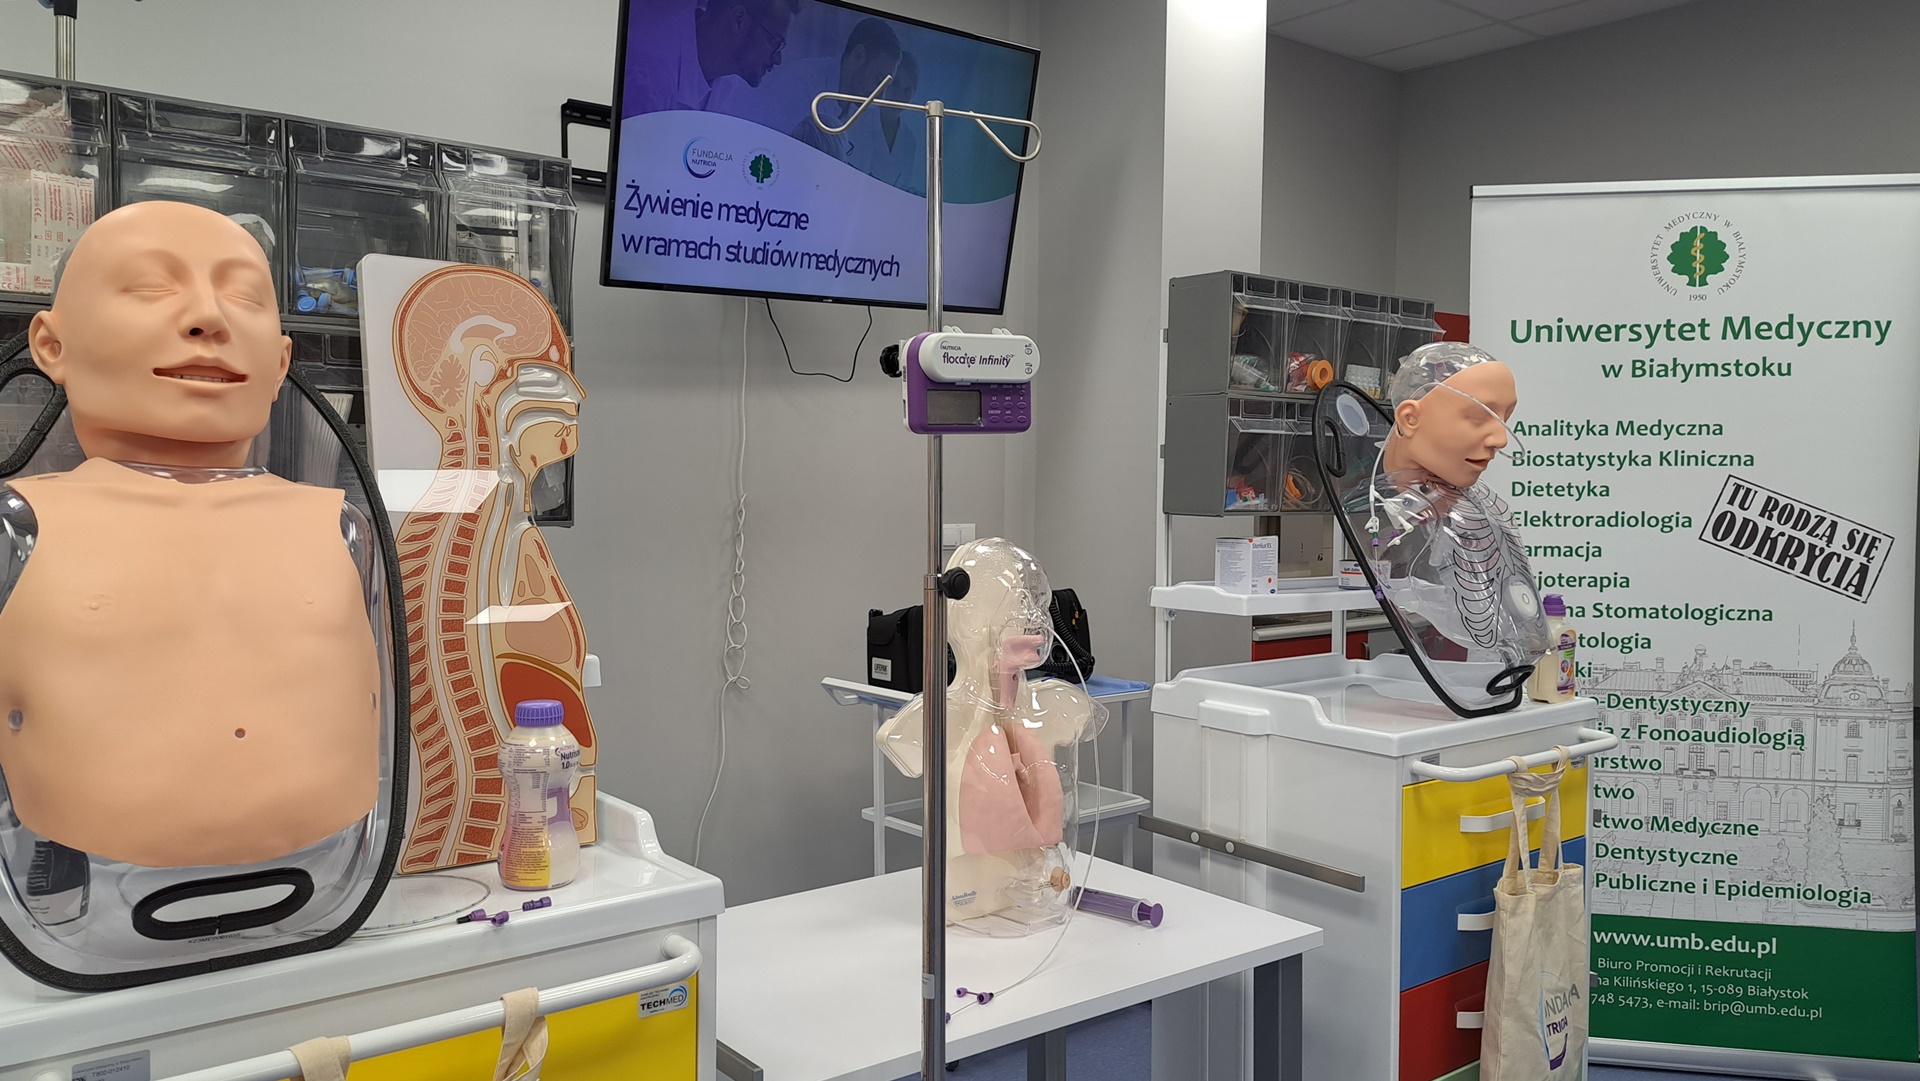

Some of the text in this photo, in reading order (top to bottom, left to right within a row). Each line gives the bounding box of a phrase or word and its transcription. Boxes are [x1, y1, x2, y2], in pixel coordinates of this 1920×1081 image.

[692, 148, 733, 162] FUNDACJA
[624, 179, 810, 232] Żywienie medyczne
[1663, 211, 1720, 232] MEDYCZNY
[1724, 219, 1734, 229] W
[645, 235, 721, 261] ramach
[725, 240, 798, 269] studiów
[800, 251, 901, 282] medycznych
[1650, 233, 1678, 297] UNIWERSYTET
[1688, 294, 1708, 302] 1950
[1510, 313, 1892, 349] Uniwersytet Medyczny
[978, 355, 1011, 368] Infinity
[1601, 356, 1793, 383] w Białymstoku
[1512, 419, 1724, 440] Analityka Medyczna
[1512, 450, 1755, 471] Biostatystyka Kliniczna
[1511, 481, 1610, 501] Dietetyka
[1511, 510, 1693, 534] Elektroradiologia
[1726, 481, 1882, 564] TU RODZĄ SIĘ
[1524, 541, 1602, 562] armacja
[1711, 511, 1872, 598] ODKRYCIA
[1534, 571, 1630, 592] joterapia
[1592, 602, 1774, 627] Stomatologiczna
[1578, 632, 1652, 655] tologia
[1590, 693, 1750, 717] -Dentystyczny
[1620, 727, 1631, 739] z
[1637, 724, 1806, 751] Fonoaudiologią
[1650, 815, 1760, 838] Medyczne
[1595, 843, 1739, 867] Dentystyczne
[1595, 873, 1872, 908] Publiczne i Epidemiologia
[1593, 931, 1777, 959] www.umb.edu.pl
[1598, 958, 1772, 982] Biuro Promocji i Rekrutacji
[1614, 976, 1684, 995] Kilińskiego
[1688, 984, 1697, 994] 1,
[1701, 984, 1743, 998] 15-089
[1747, 985, 1809, 1001] Białystok
[640, 994, 684, 1011] TECHMED
[1591, 993, 1822, 1020] 748 5473, e-mail: brip@umb.edu.pl
